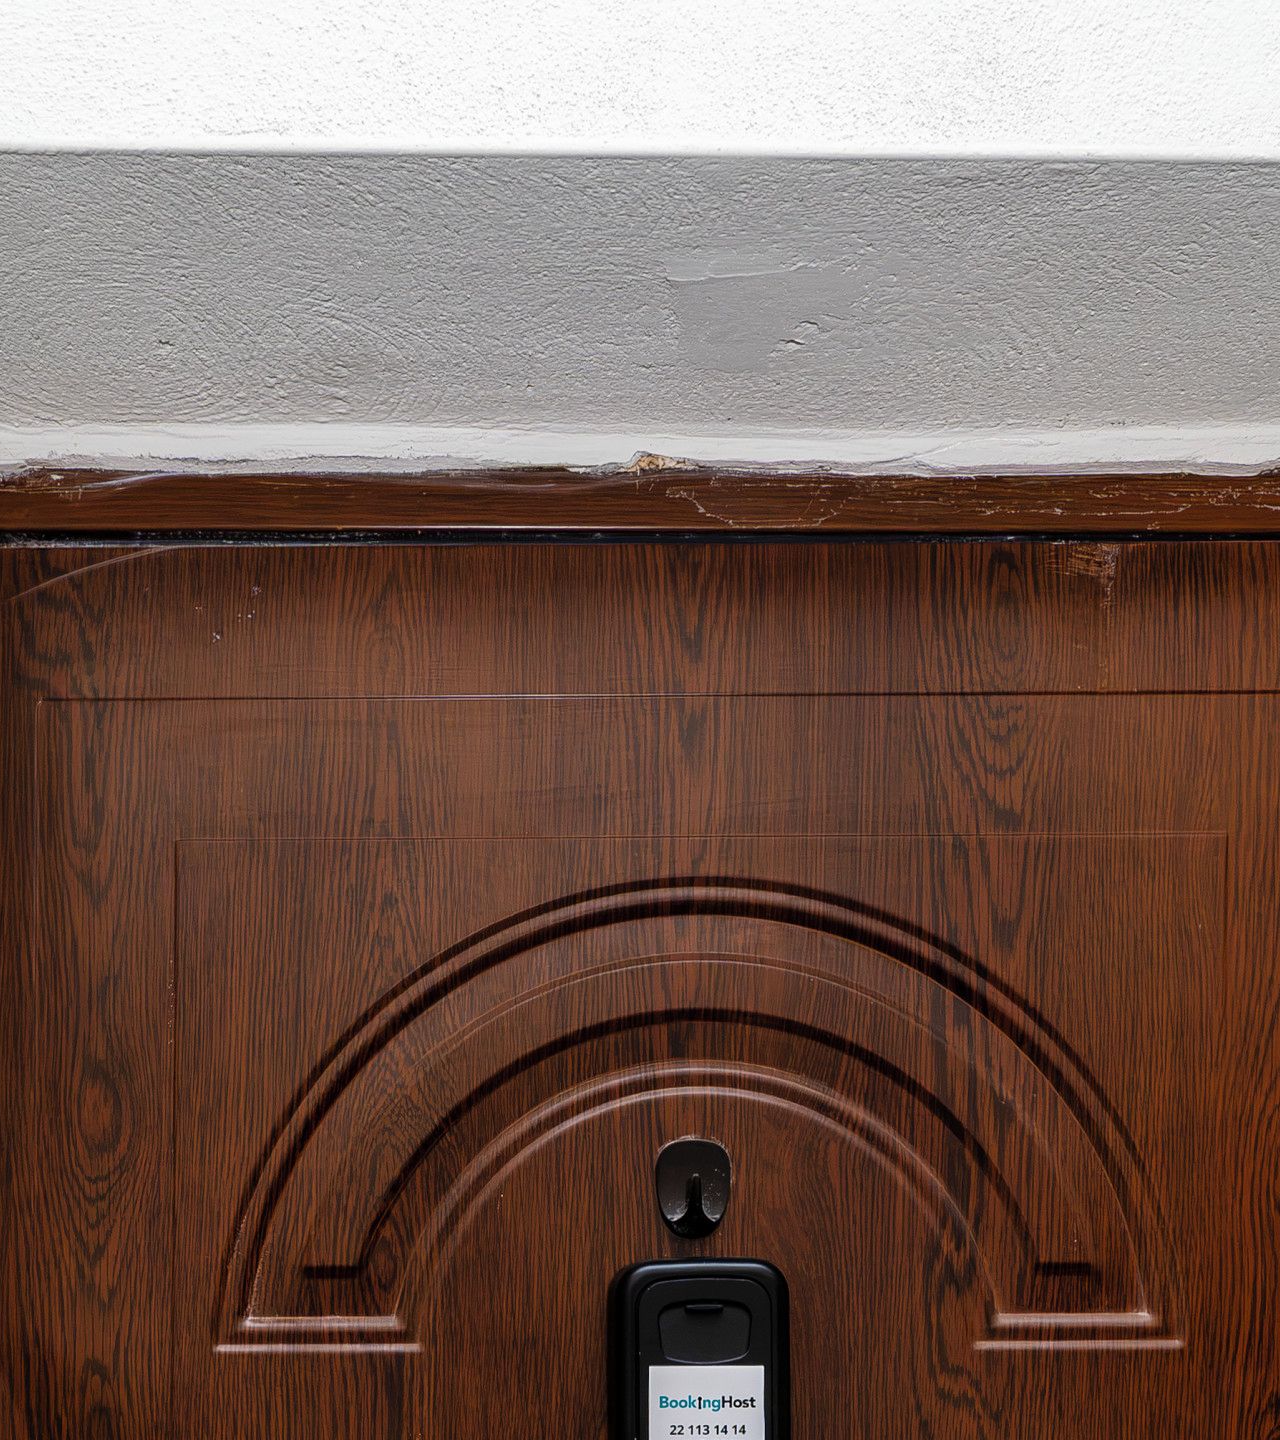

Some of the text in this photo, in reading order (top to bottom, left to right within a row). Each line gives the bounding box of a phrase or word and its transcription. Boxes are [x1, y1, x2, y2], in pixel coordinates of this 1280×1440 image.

[659, 1395, 756, 1412] BookingHost
[669, 1424, 746, 1436] 22 113 14 14
